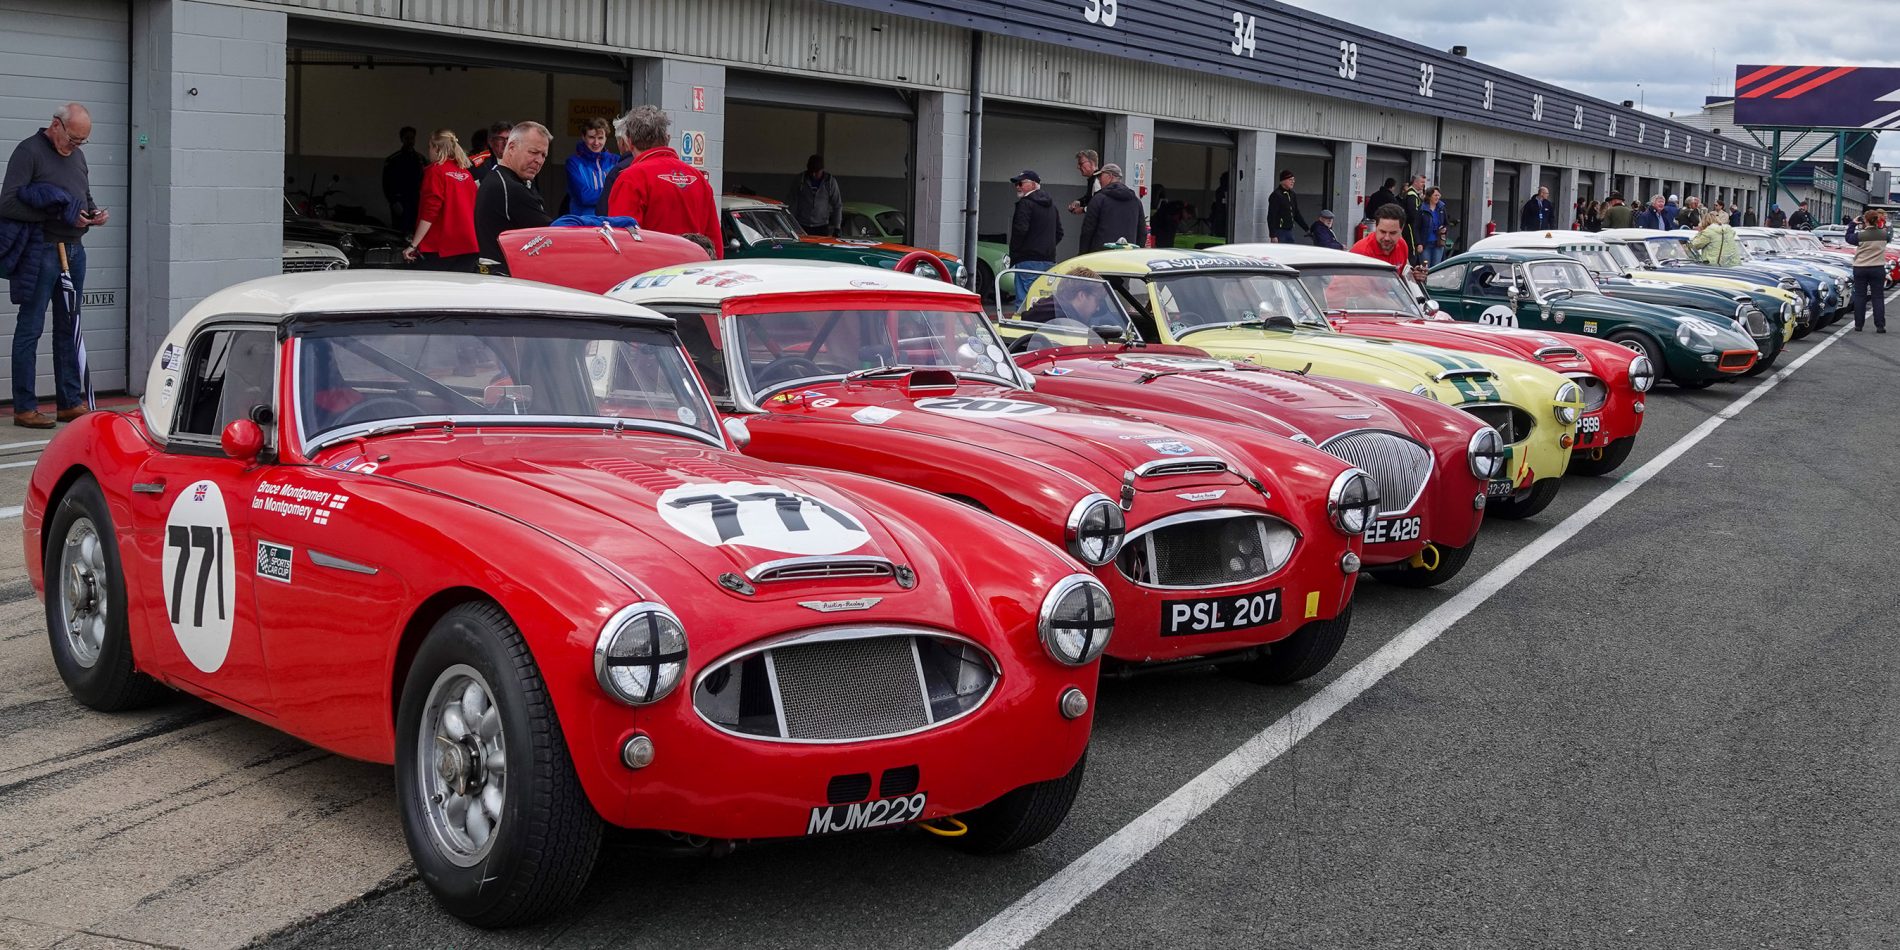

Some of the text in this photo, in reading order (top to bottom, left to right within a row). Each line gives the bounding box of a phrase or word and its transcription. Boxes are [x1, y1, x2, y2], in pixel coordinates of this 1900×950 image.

[1232, 12, 1256, 58] 34
[1338, 40, 1358, 80] 33
[1418, 62, 1434, 97] 32
[1484, 80, 1493, 110] 31
[1532, 94, 1543, 121] 30
[574, 104, 615, 115] CAUTION
[1573, 104, 1584, 130] 29
[1608, 113, 1617, 138] 28
[1638, 122, 1646, 144] 27
[920, 397, 1049, 414] 207
[1582, 416, 1600, 433] 999
[257, 480, 331, 506] Bruce Montgomery
[251, 495, 313, 521] Ian Montgomery
[664, 492, 865, 544] 771
[1363, 516, 1421, 544] EE 426
[269, 547, 278, 557] GT
[271, 556, 291, 569] SPORTS
[168, 525, 226, 628] 771
[267, 564, 290, 577] CAR CUP
[1171, 592, 1277, 632] PSL 207
[807, 793, 926, 835] MJM229
